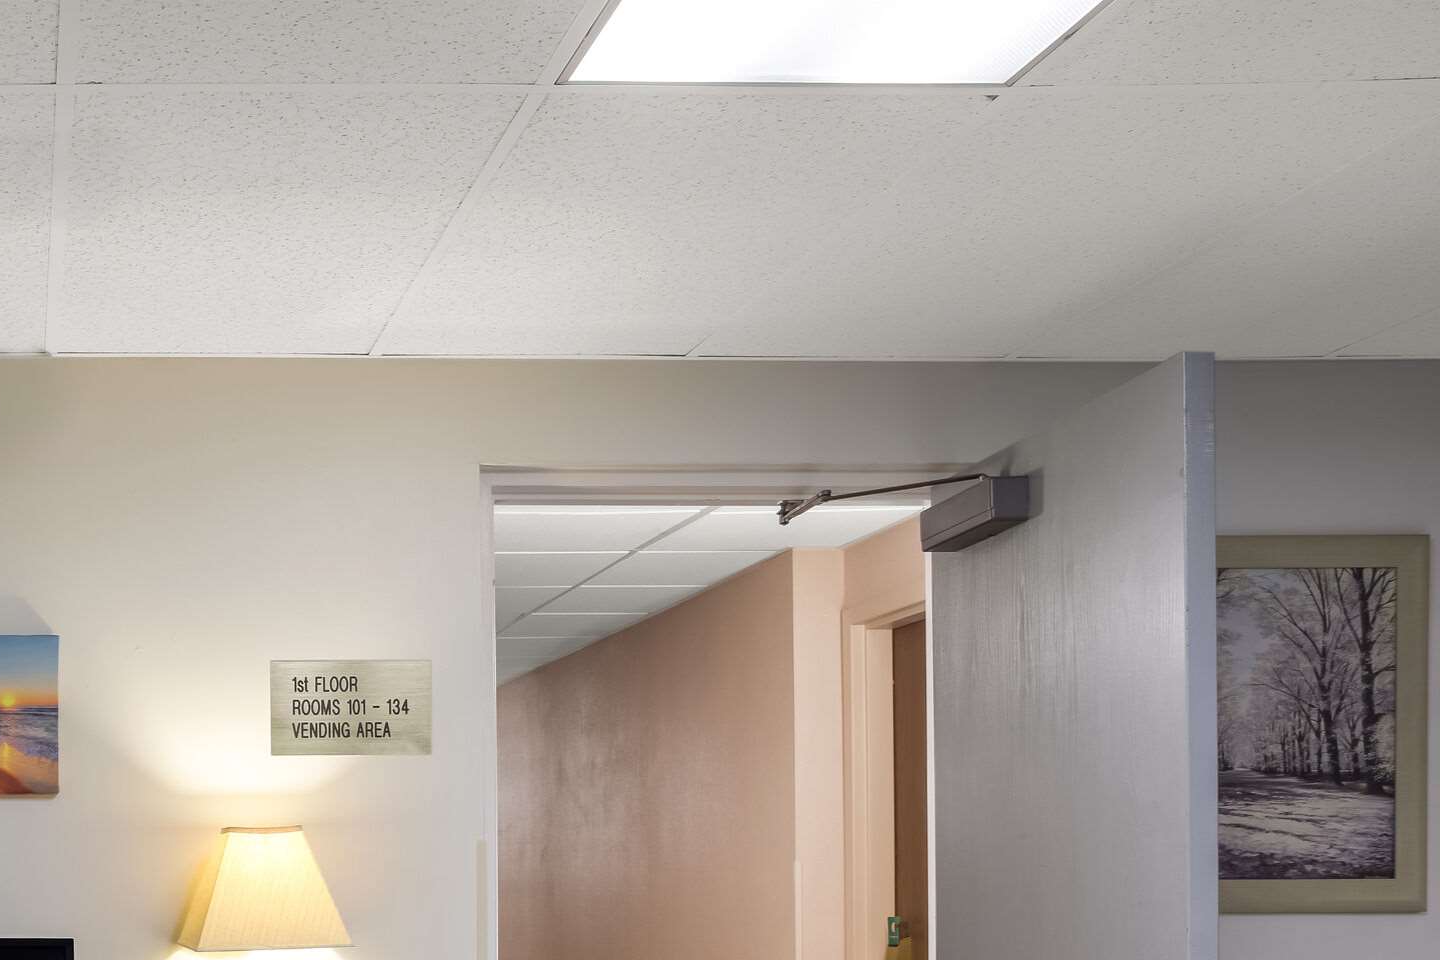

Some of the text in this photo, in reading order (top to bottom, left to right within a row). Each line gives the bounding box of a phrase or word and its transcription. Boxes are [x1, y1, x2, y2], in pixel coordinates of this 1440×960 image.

[292, 676, 358, 692] 1st FLOOR
[292, 699, 340, 715] ROOMS
[347, 699, 366, 715] 101
[386, 699, 410, 715] 134
[292, 722, 391, 739] VENDING AREA
